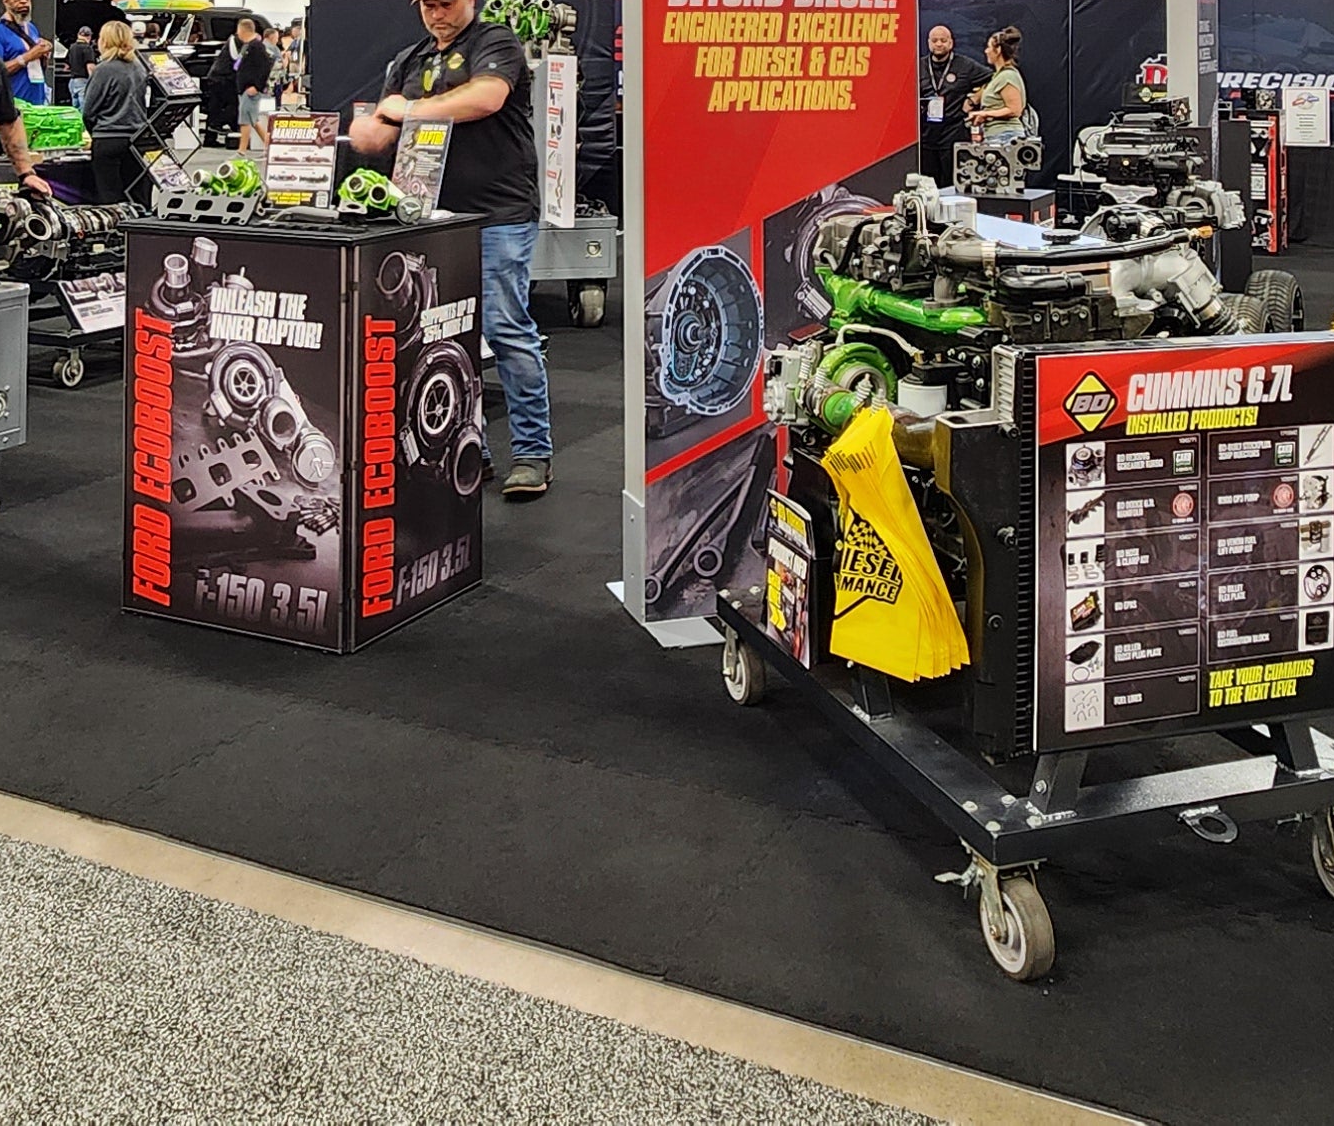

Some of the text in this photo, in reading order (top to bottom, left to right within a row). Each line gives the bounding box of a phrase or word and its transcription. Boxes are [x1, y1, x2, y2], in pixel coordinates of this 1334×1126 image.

[663, 11, 900, 43] ENGINEERED EXCELLENCE
[695, 46, 870, 77] FOR DIESEL & GAS
[708, 80, 856, 113] APPLICATIONS.
[271, 128, 318, 141] MANIFOLDS
[417, 130, 447, 145] RAPTOR
[210, 287, 307, 320] UNLEASH THE
[209, 313, 323, 349] INNER RAPTOR!
[1071, 394, 1111, 413] BD
[1127, 364, 1293, 412] CUMMINS 6.7L
[1126, 406, 1259, 435] INSTALLED PRODUCTS!
[133, 308, 173, 606] FORD ECOBOOST
[362, 315, 396, 618] FORD ECOBOOST
[396, 548, 438, 606] F-150
[842, 550, 903, 583] IESEL
[195, 568, 265, 623] F-150
[1209, 659, 1314, 689] TAKE YOUR CUMMINS
[1209, 679, 1297, 707] TO THE NEXT LEVEL
